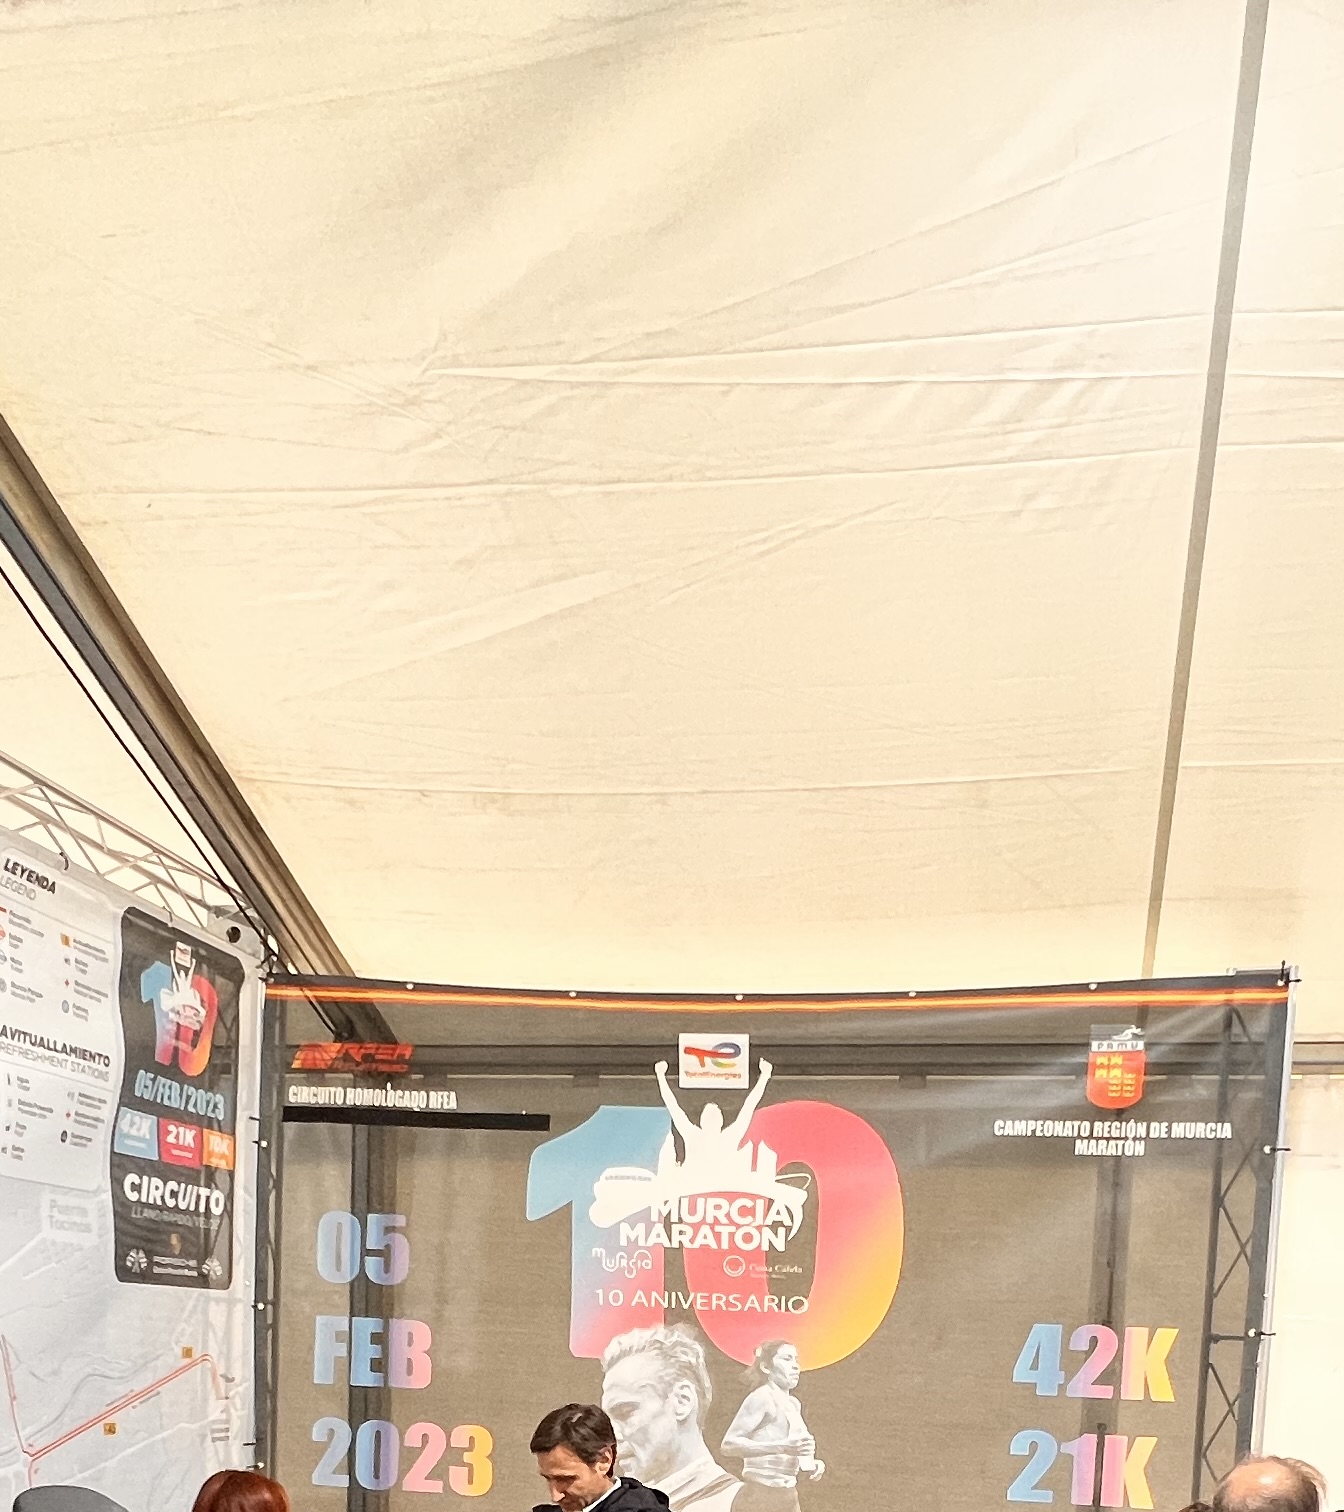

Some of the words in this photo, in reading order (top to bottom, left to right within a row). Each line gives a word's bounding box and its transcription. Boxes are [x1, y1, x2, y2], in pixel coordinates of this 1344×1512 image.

[3, 858, 56, 894] LEYENDA
[0, 1024, 111, 1068] AVITUALLAMIENTO
[0, 1041, 68, 1069] REFRESHMENT
[70, 1060, 110, 1082] STATIONS
[134, 1069, 225, 1121] 05/FEB/2023
[288, 1085, 344, 1105] CIRCUITO
[346, 1087, 427, 1109] HOMOLOGADO
[428, 1090, 457, 1110] RFEA
[165, 1124, 196, 1149] 21K
[993, 1119, 1091, 1138] CAMPEONATO
[1092, 1118, 1147, 1139] REGIÓN
[1149, 1121, 1169, 1139] DE
[1170, 1122, 1233, 1139] MURCIA
[1074, 1137, 1145, 1156] MARATÓN
[123, 1173, 225, 1216] CIRCUITO
[650, 1197, 792, 1227] MURCIA
[316, 1209, 411, 1287] 05
[595, 1288, 624, 1307] 10
[631, 1289, 809, 1315] ANIVERSARIO
[312, 1315, 433, 1390] FEB
[1012, 1323, 1180, 1403] 42K
[311, 1417, 495, 1497] 2023
[1006, 1429, 1158, 1511] 21K
